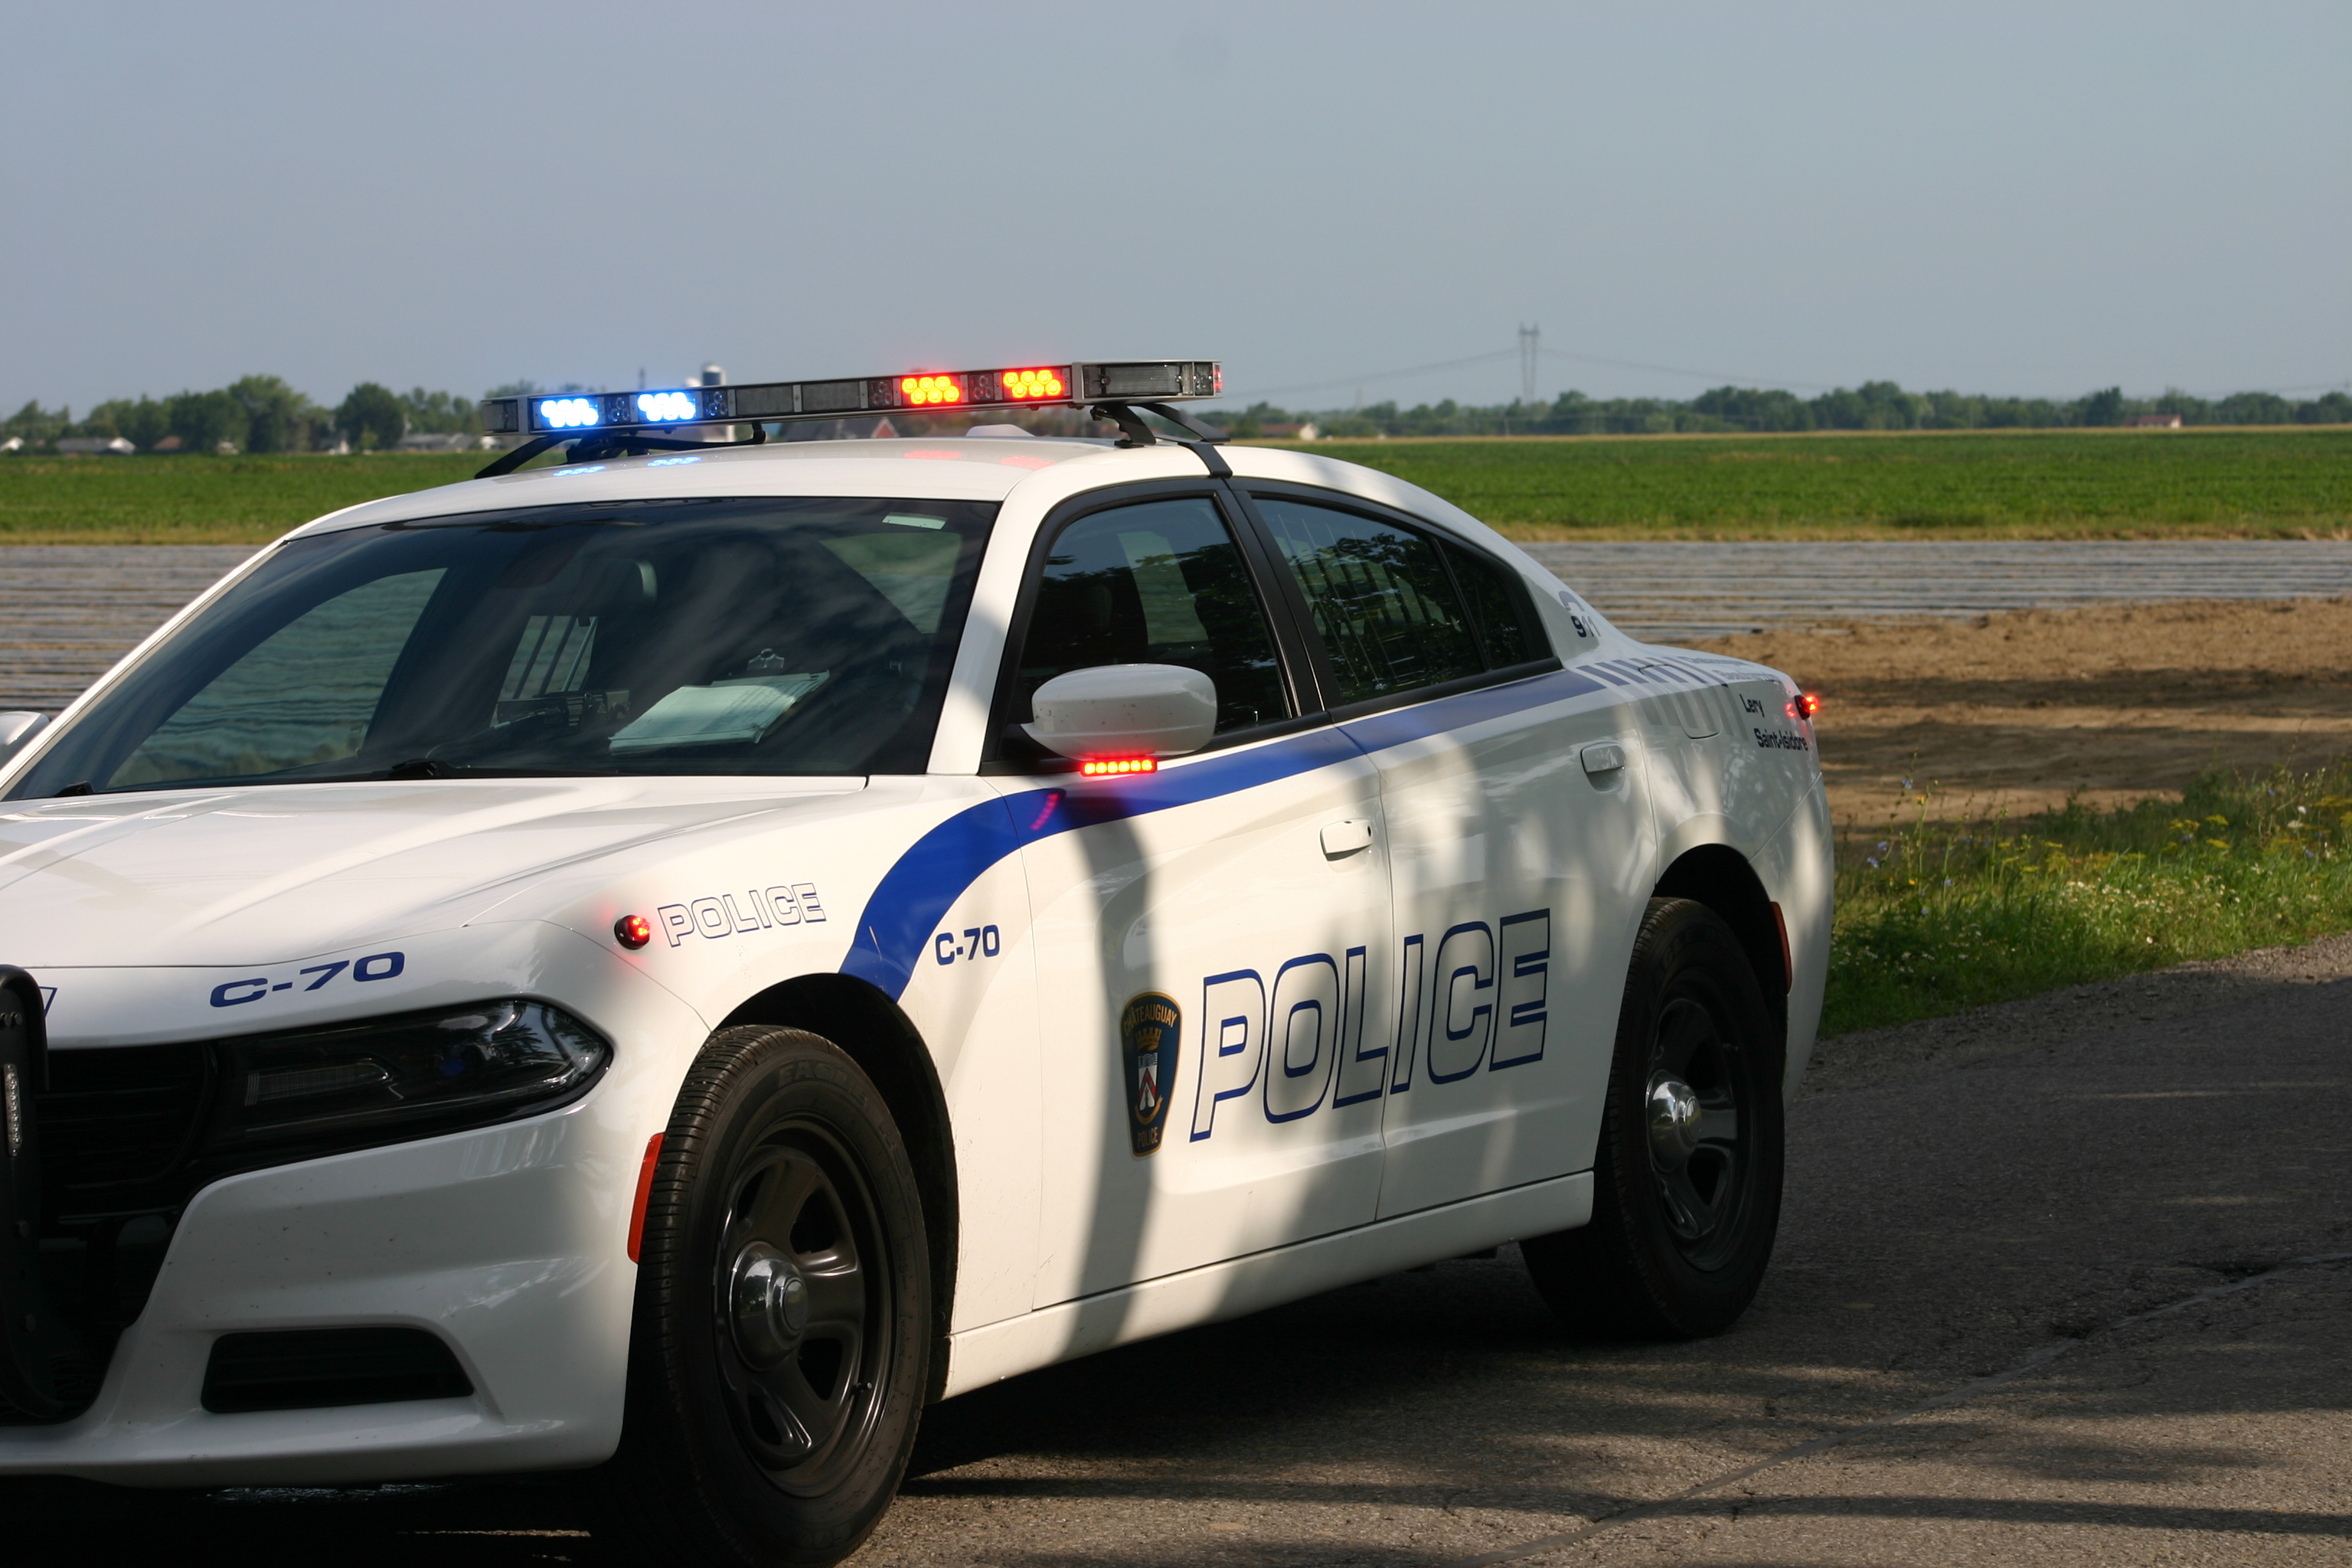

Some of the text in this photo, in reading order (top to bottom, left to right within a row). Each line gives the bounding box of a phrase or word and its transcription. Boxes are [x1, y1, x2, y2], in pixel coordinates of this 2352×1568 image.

[1570, 616, 1601, 639] 911
[658, 883, 826, 948] POLICE
[936, 924, 1000, 966] C-70
[210, 952, 405, 1008] C-70
[1123, 1004, 1178, 1037] CHÂTEAUGUAY
[1189, 908, 1551, 1143] POLICE
[1137, 1125, 1159, 1148] POLICE
